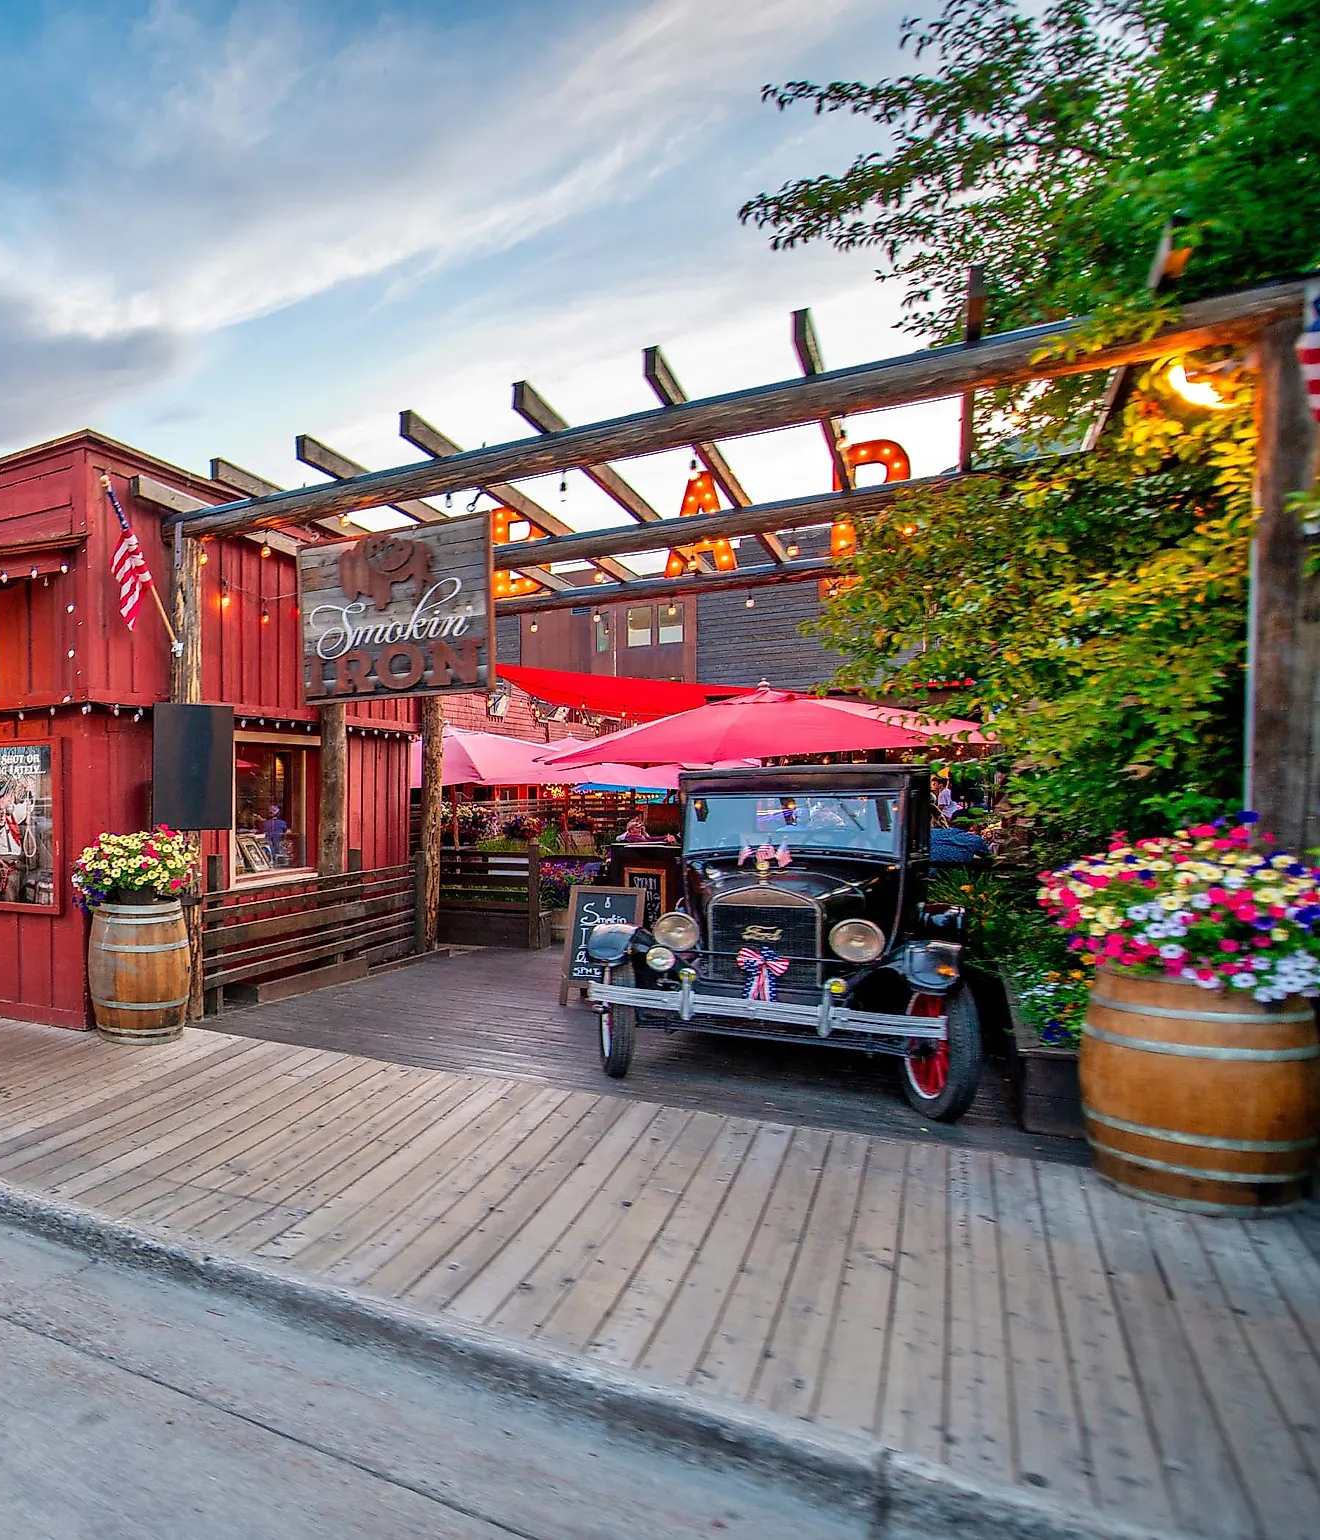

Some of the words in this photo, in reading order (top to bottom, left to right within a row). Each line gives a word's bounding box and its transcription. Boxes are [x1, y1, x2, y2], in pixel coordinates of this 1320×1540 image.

[304, 637, 481, 697] IRON
[0, 754, 25, 766] SHOT
[26, 753, 41, 765] OR
